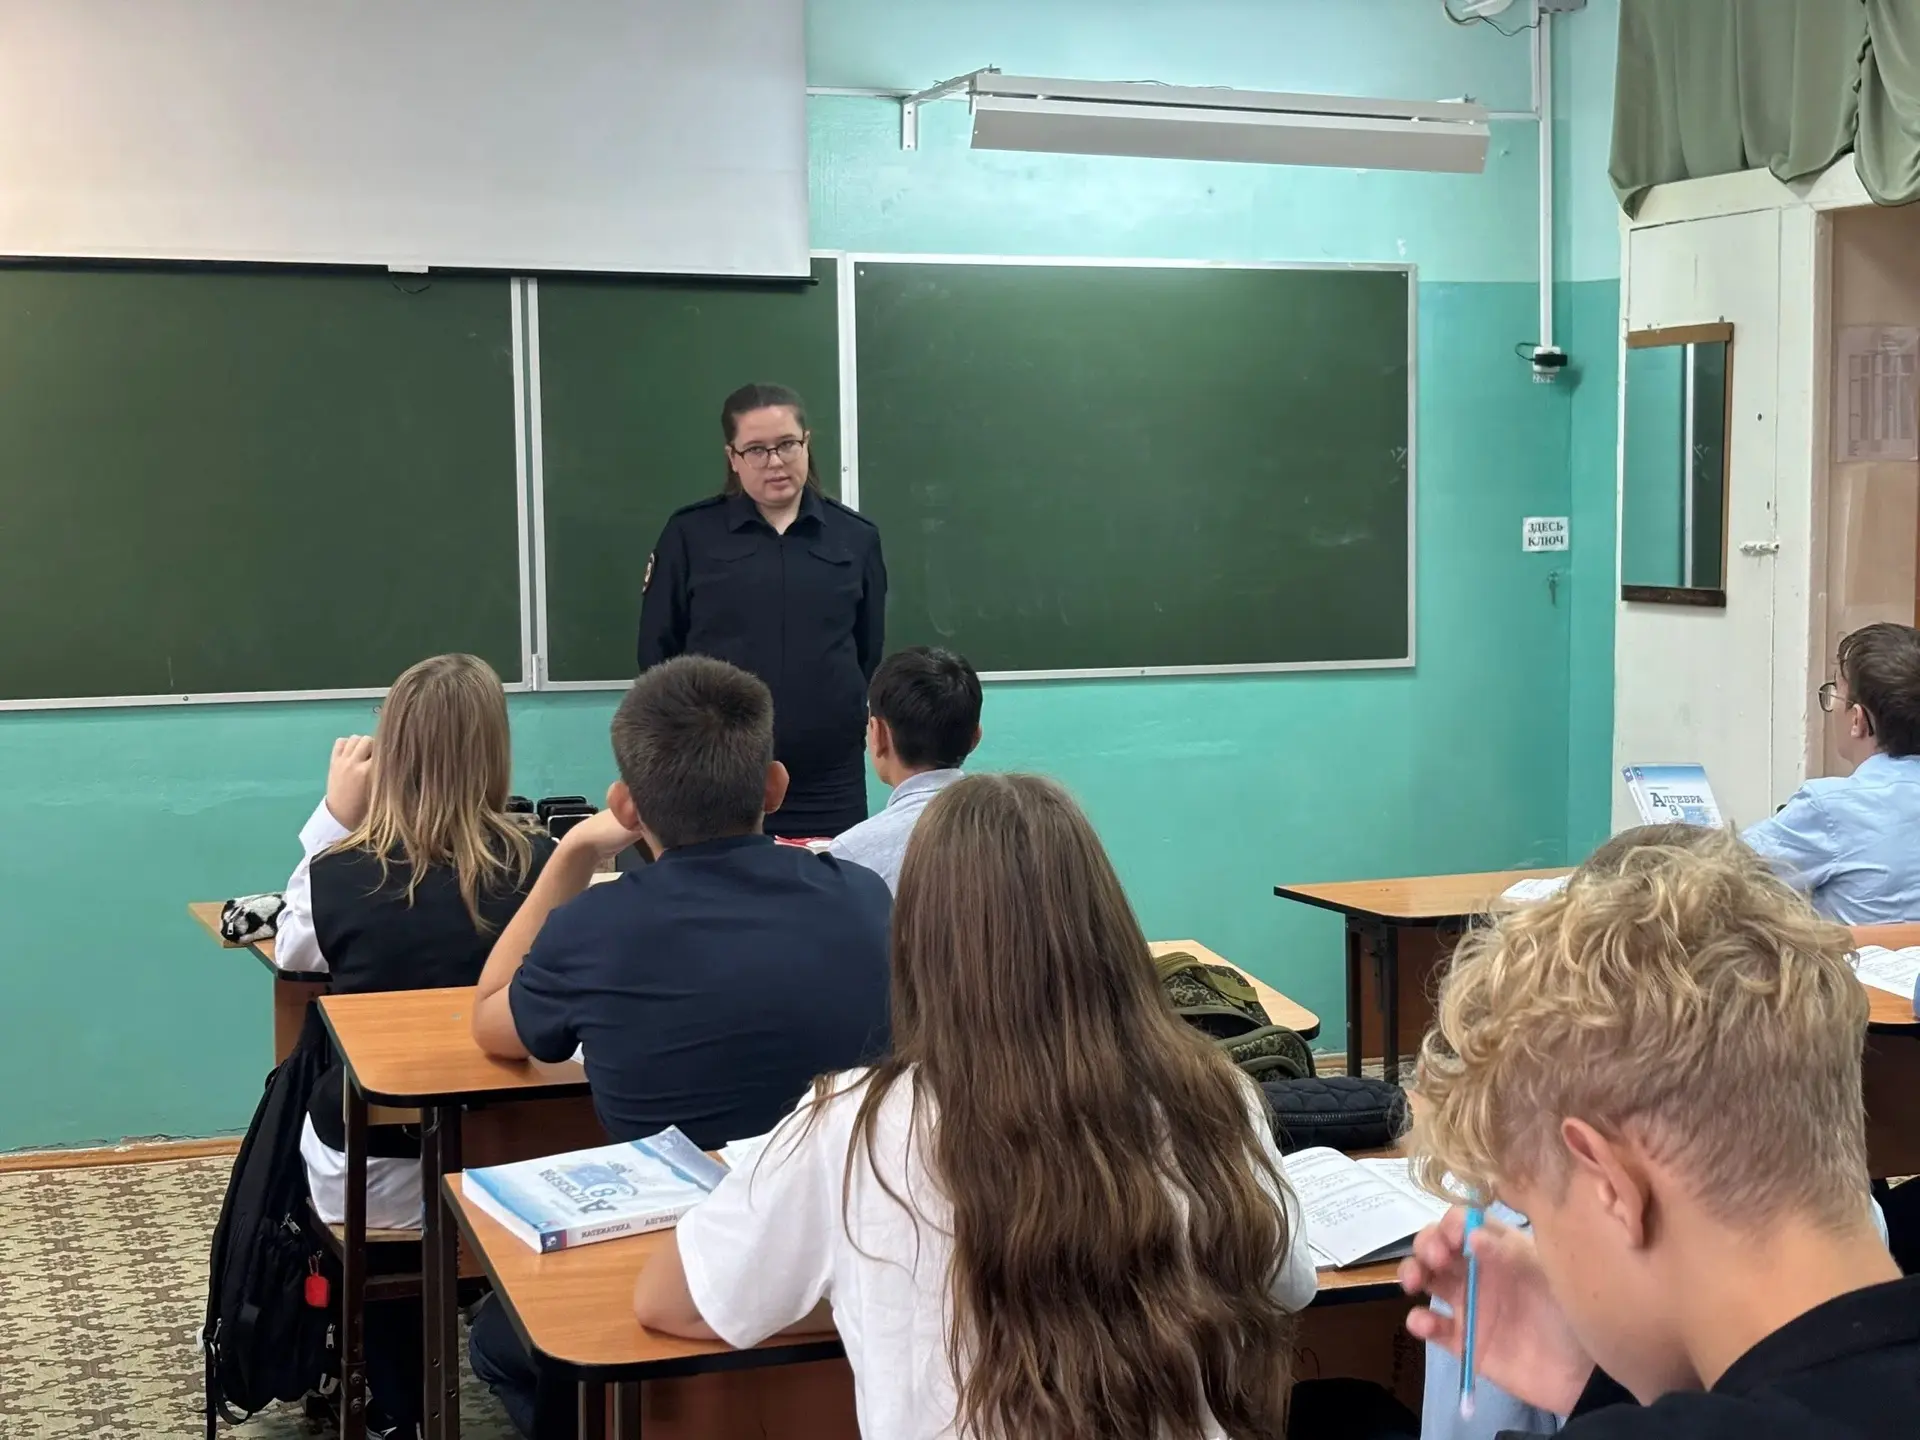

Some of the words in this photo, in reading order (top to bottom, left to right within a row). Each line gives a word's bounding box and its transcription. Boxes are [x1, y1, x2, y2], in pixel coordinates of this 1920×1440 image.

[1528, 521, 1564, 534] ЗДЕСЬ
[1528, 535, 1564, 547] КЛЮЧ
[1669, 804, 1679, 817] 8
[590, 1187, 617, 1198] 8
[580, 1222, 632, 1239] МАТЕМАТИКА
